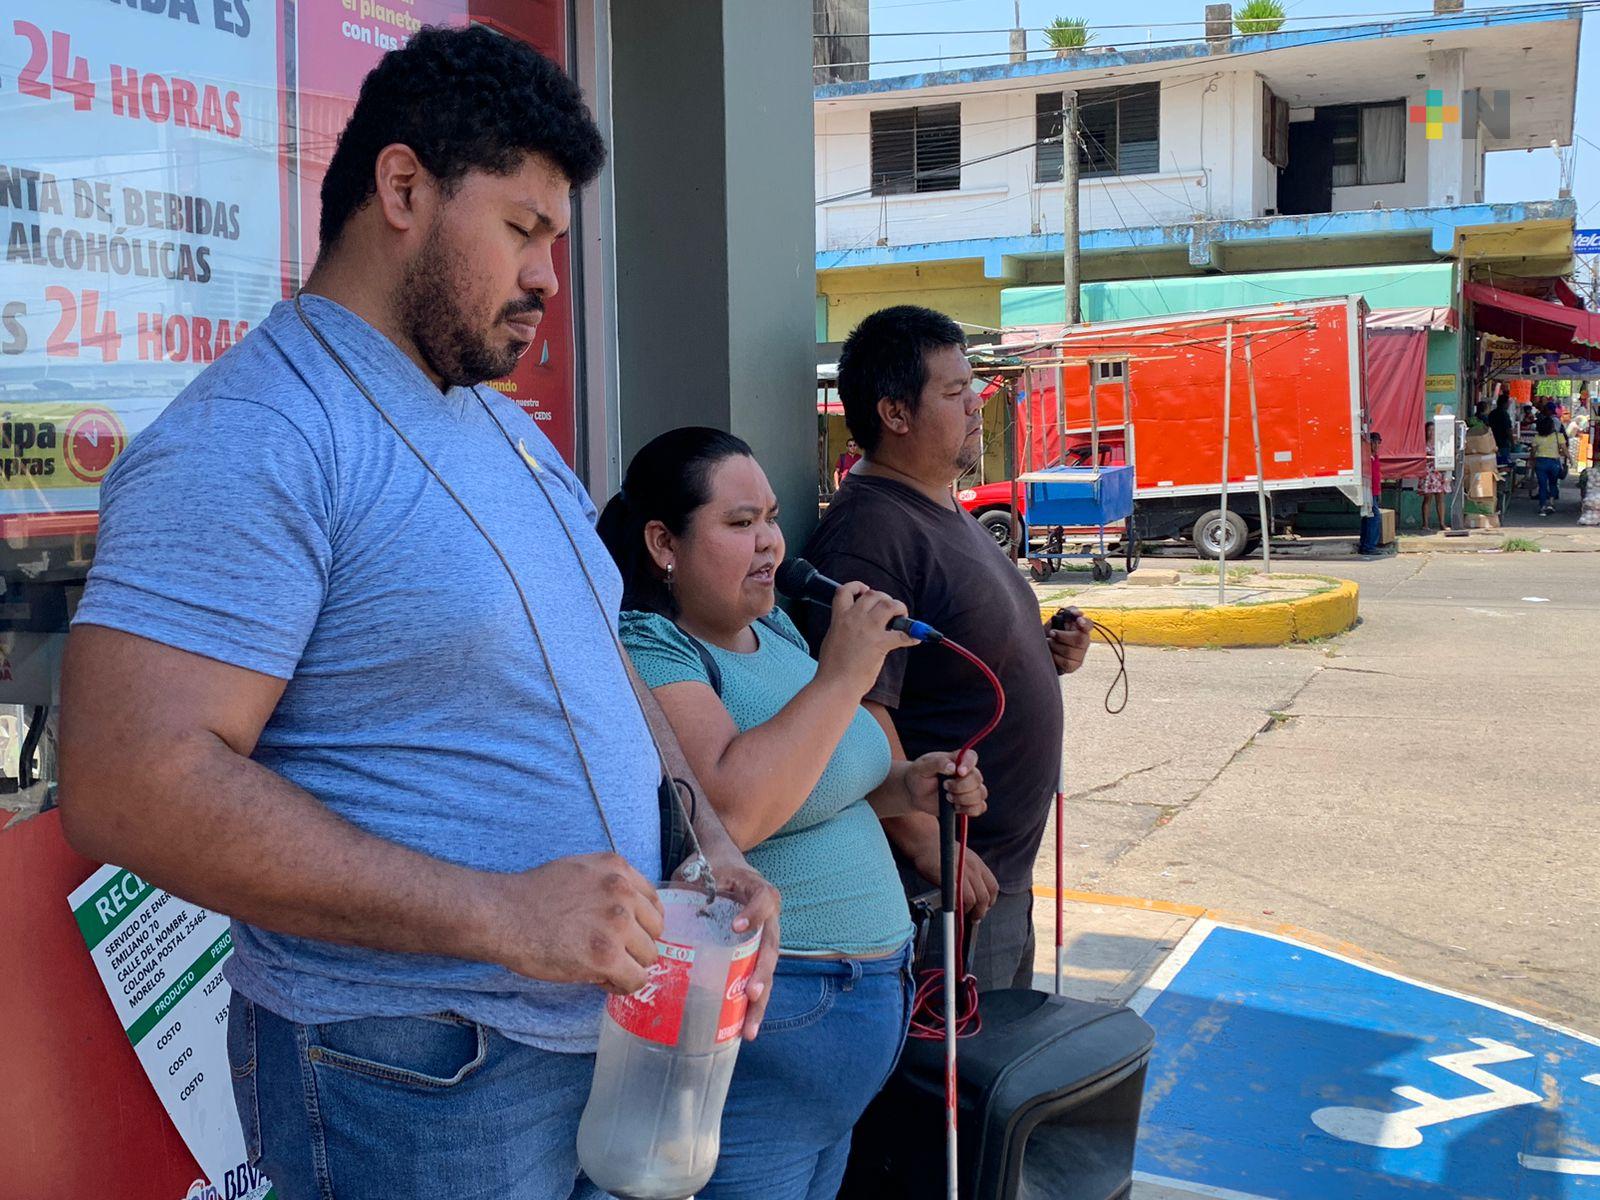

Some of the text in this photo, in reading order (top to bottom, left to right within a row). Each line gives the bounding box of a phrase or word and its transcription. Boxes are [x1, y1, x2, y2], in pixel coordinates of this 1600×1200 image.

[342, 21, 371, 45] con
[13, 20, 242, 138] 24 HORAS
[72, 178, 113, 223] DE
[122, 187, 240, 240] BEBIDAS
[6, 222, 211, 283] ALCOHÓLICAS
[45, 286, 122, 362] 24
[105, 920, 140, 957] SERVICIO
[140, 909, 152, 924] DE
[111, 920, 159, 970] EMILIANO 70
[117, 910, 188, 982] CALLE DEL NOMBRE
[123, 909, 207, 995] COLONIA POSTAL 25462
[129, 968, 166, 1009] MORELOS
[154, 931, 232, 1016] PRODUCTO PERIO
[156, 1021, 182, 1050] COSTO
[168, 1047, 193, 1076] COSTO
[180, 1072, 204, 1101] COSTO
